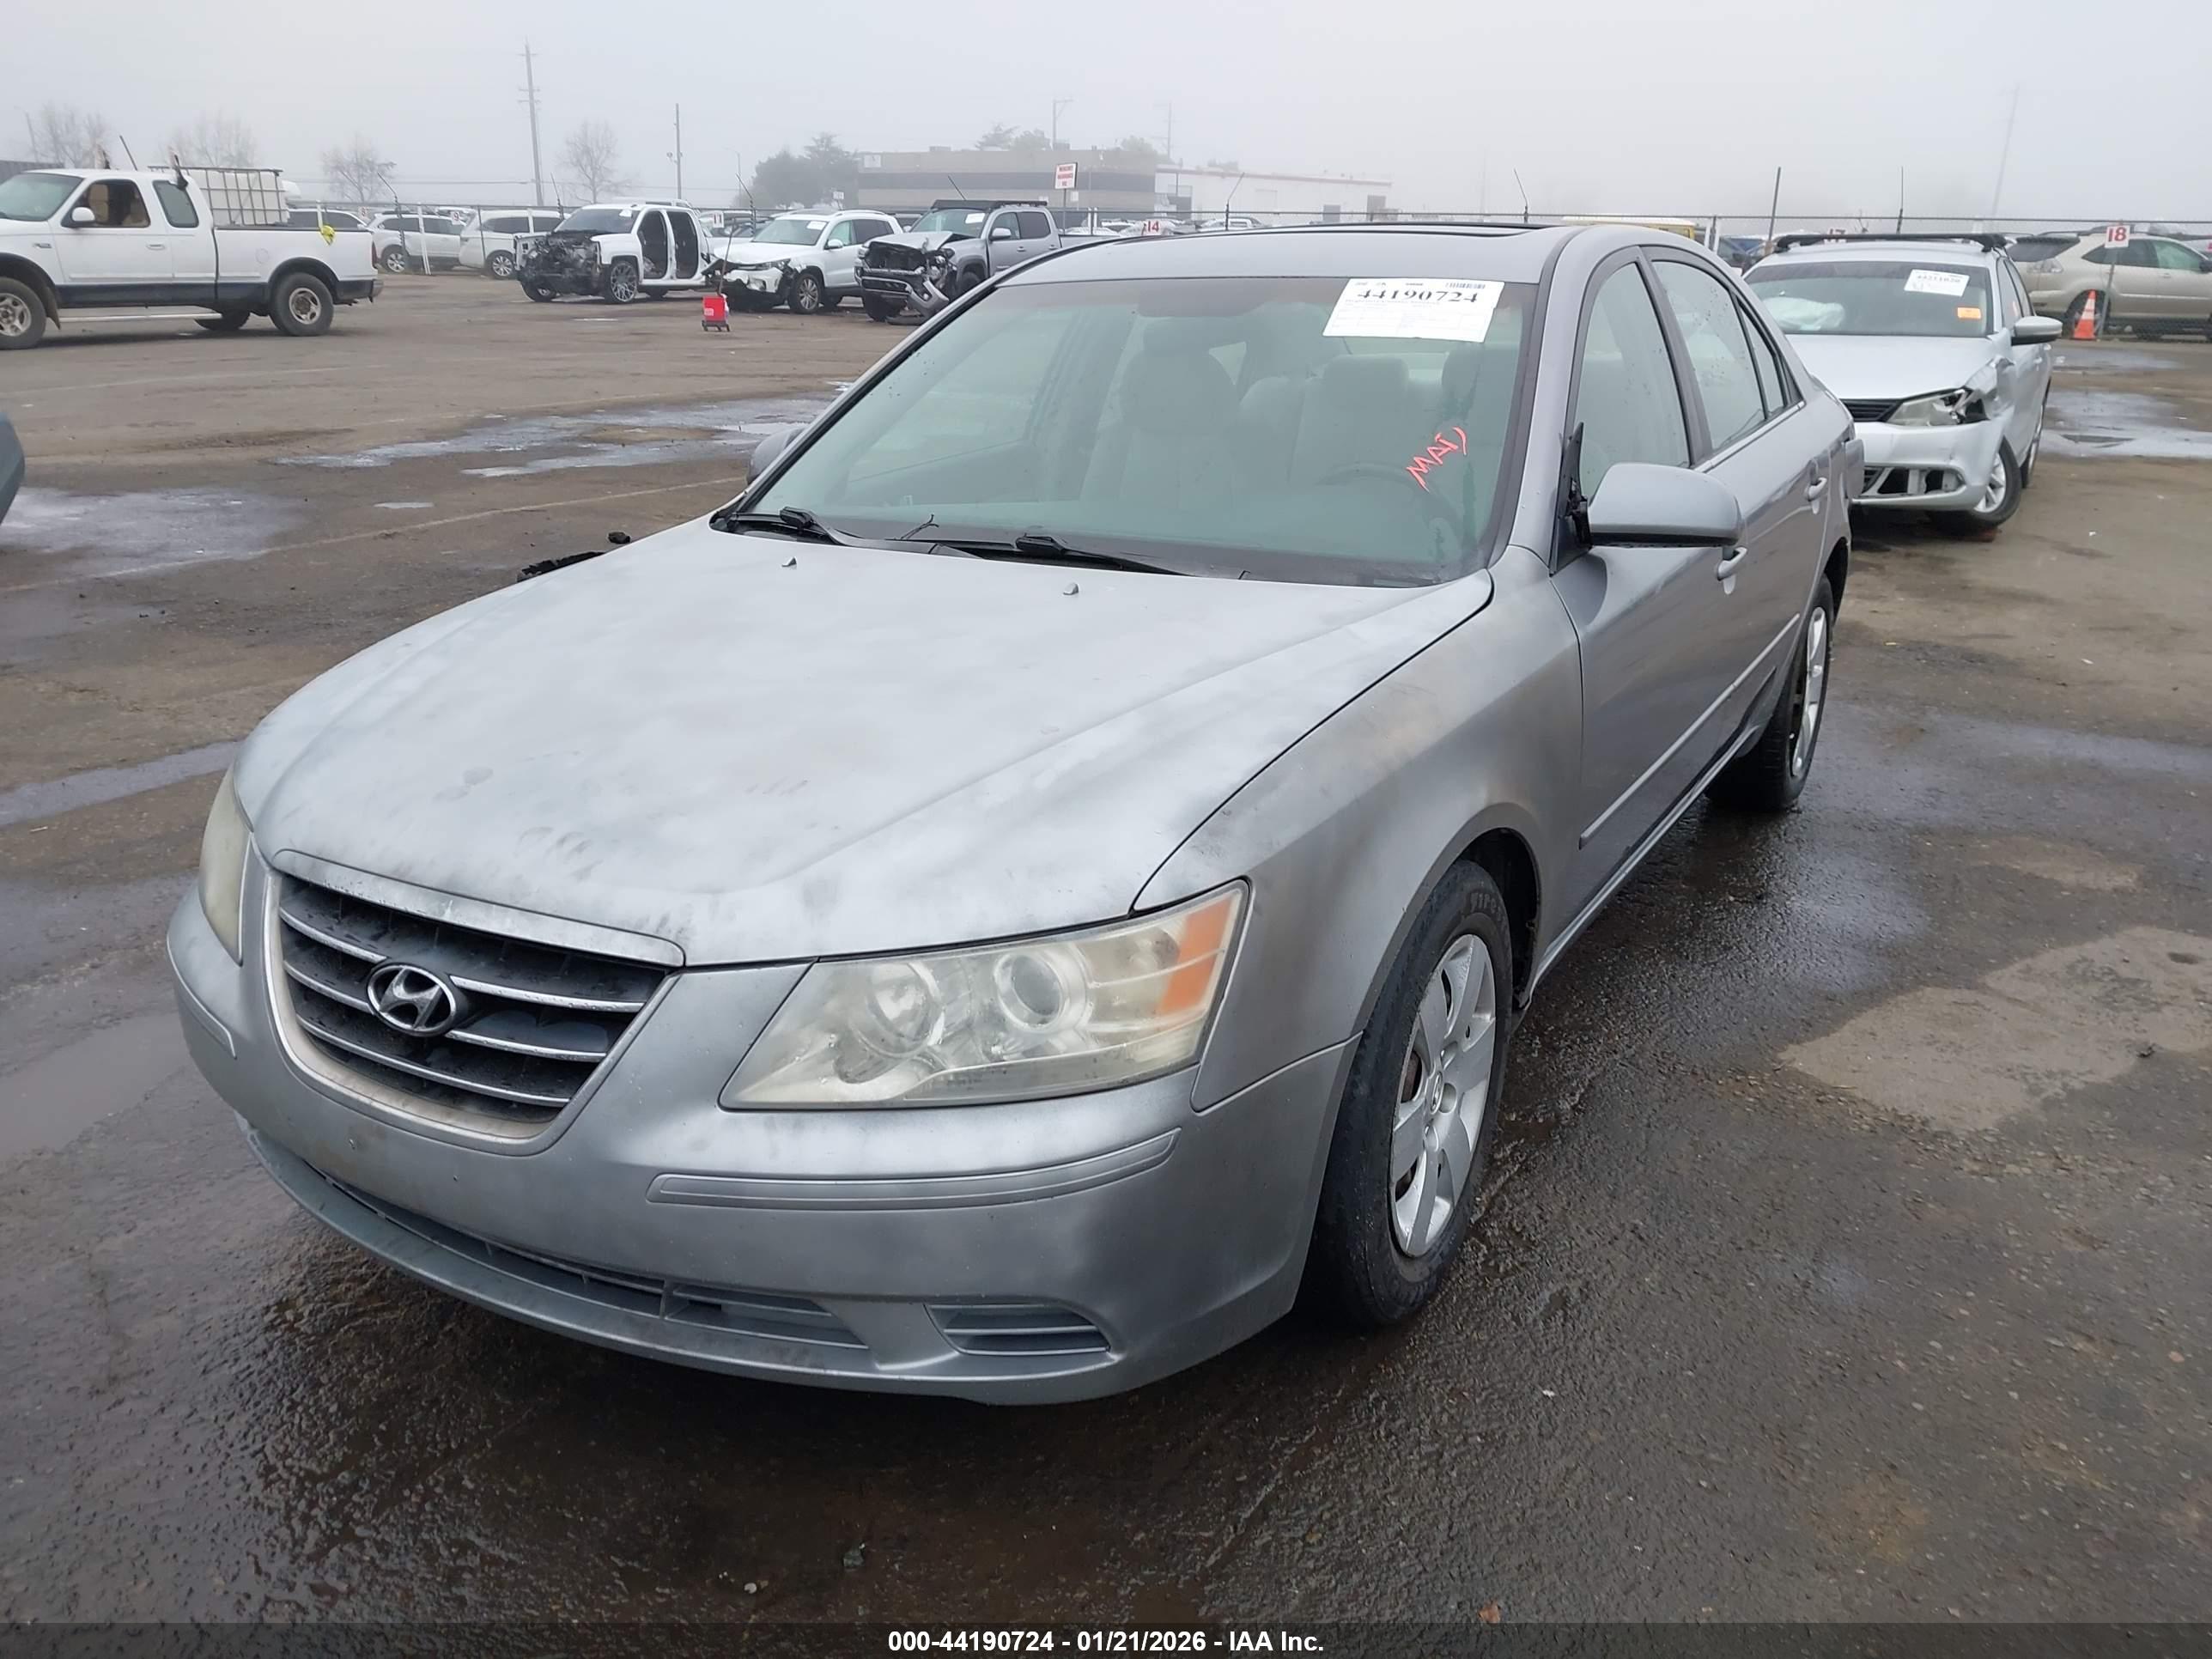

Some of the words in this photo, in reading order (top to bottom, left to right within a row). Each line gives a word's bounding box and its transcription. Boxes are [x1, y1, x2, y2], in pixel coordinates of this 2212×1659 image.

[1147, 220, 1159, 232] 14
[2108, 226, 2127, 242] 18
[1357, 289, 1479, 303] 44190724
